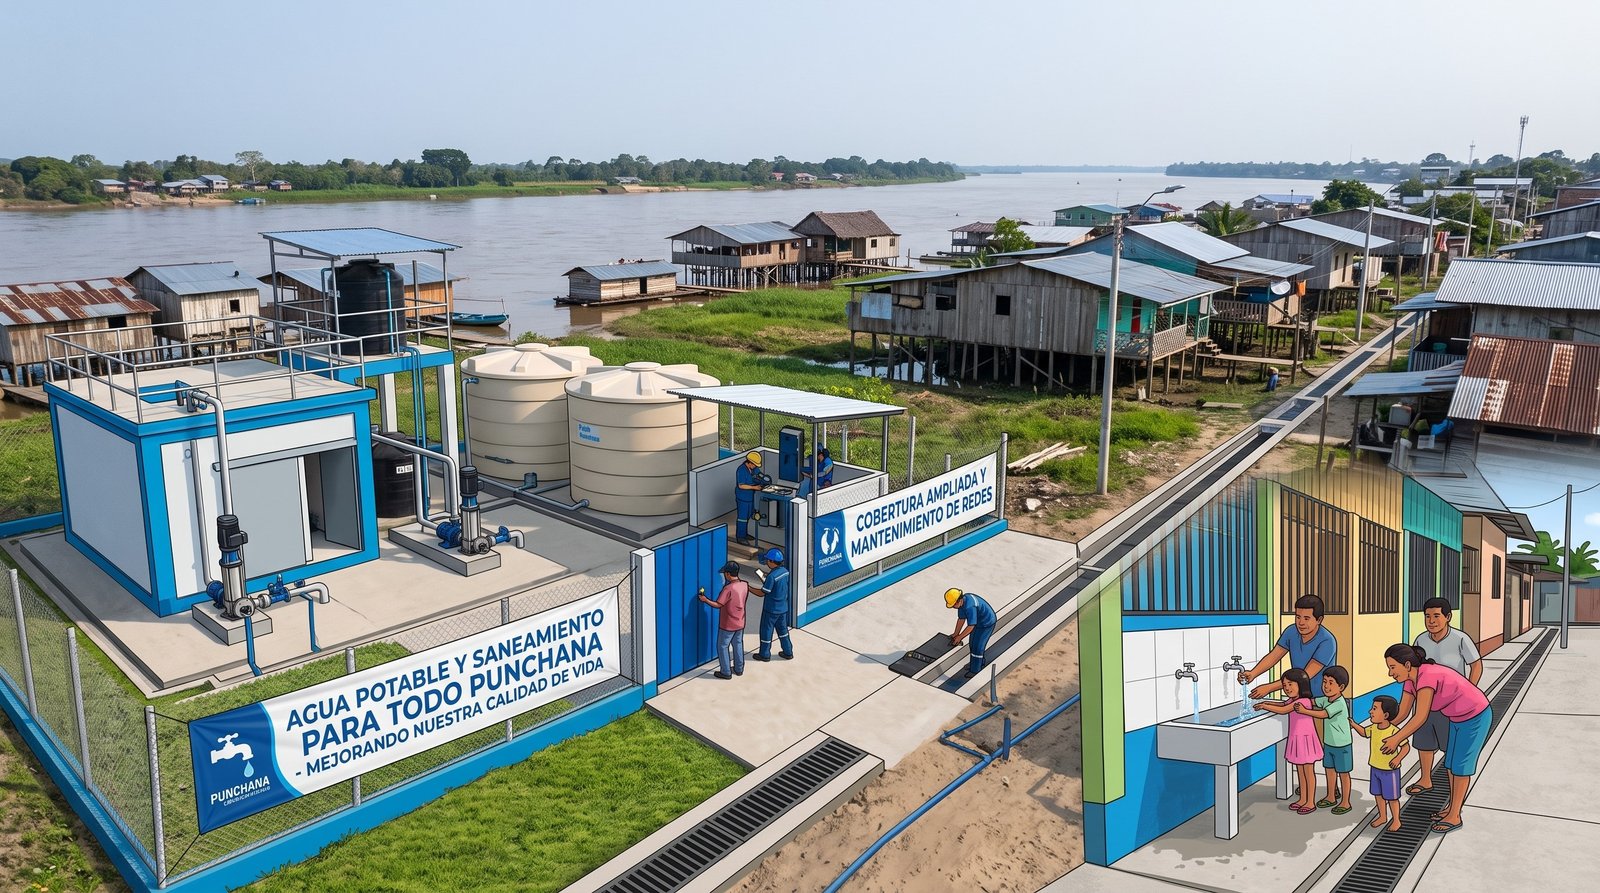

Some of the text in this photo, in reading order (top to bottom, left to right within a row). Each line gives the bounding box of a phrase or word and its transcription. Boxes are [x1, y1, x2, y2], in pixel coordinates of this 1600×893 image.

[851, 486, 993, 558] MANTENIMIENTO DE REDES
[856, 467, 987, 532] COBERTURA AMPLIADA Y
[286, 608, 604, 732] AGUA POTABLE Y SANEAMIENTO
[302, 632, 603, 756] PARA TODO PUNCHANA
[306, 728, 409, 777] MEJORANDO
[414, 702, 482, 738] NUESTRA
[486, 678, 548, 711] CALIDAD
[551, 669, 569, 687] DE
[572, 657, 604, 678] VIDA
[210, 775, 270, 805] PUNCHANA
